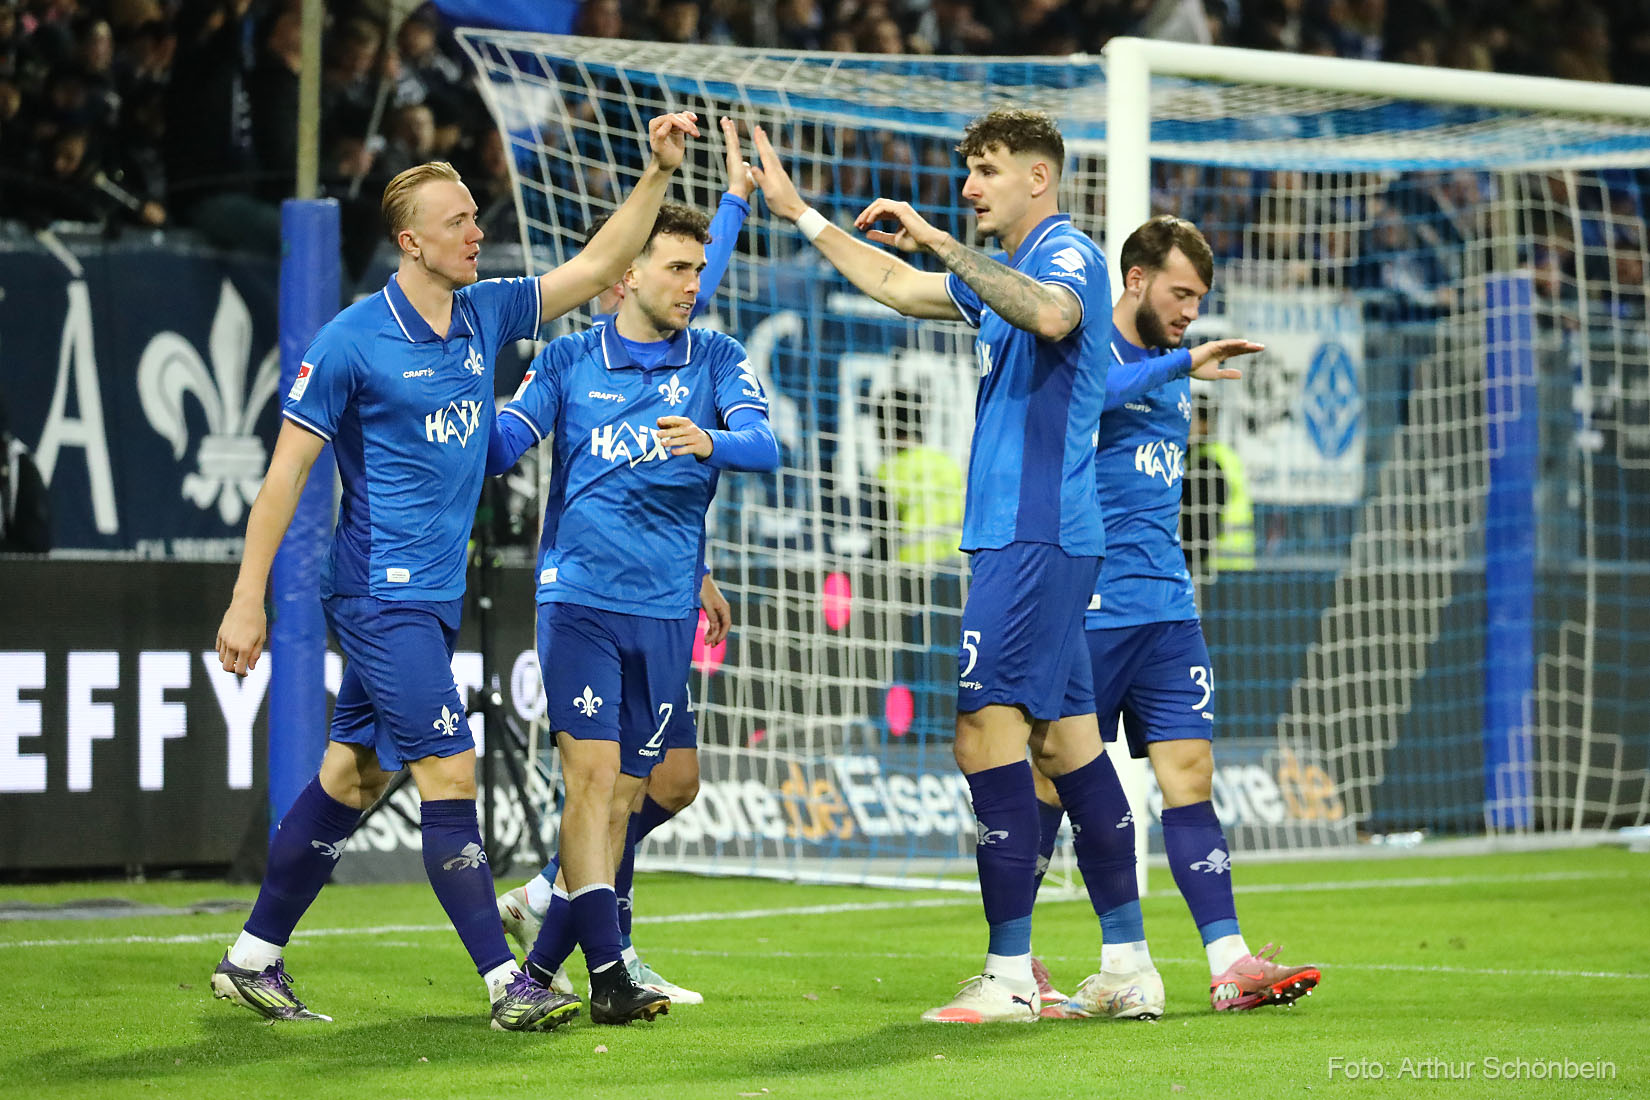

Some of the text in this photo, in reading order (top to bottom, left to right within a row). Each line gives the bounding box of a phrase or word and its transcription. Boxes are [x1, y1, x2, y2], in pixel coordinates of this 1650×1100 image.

[403, 369, 429, 379] CRAFT
[588, 391, 618, 401] CRAFT
[960, 630, 981, 678] 5
[645, 702, 673, 748] 2
